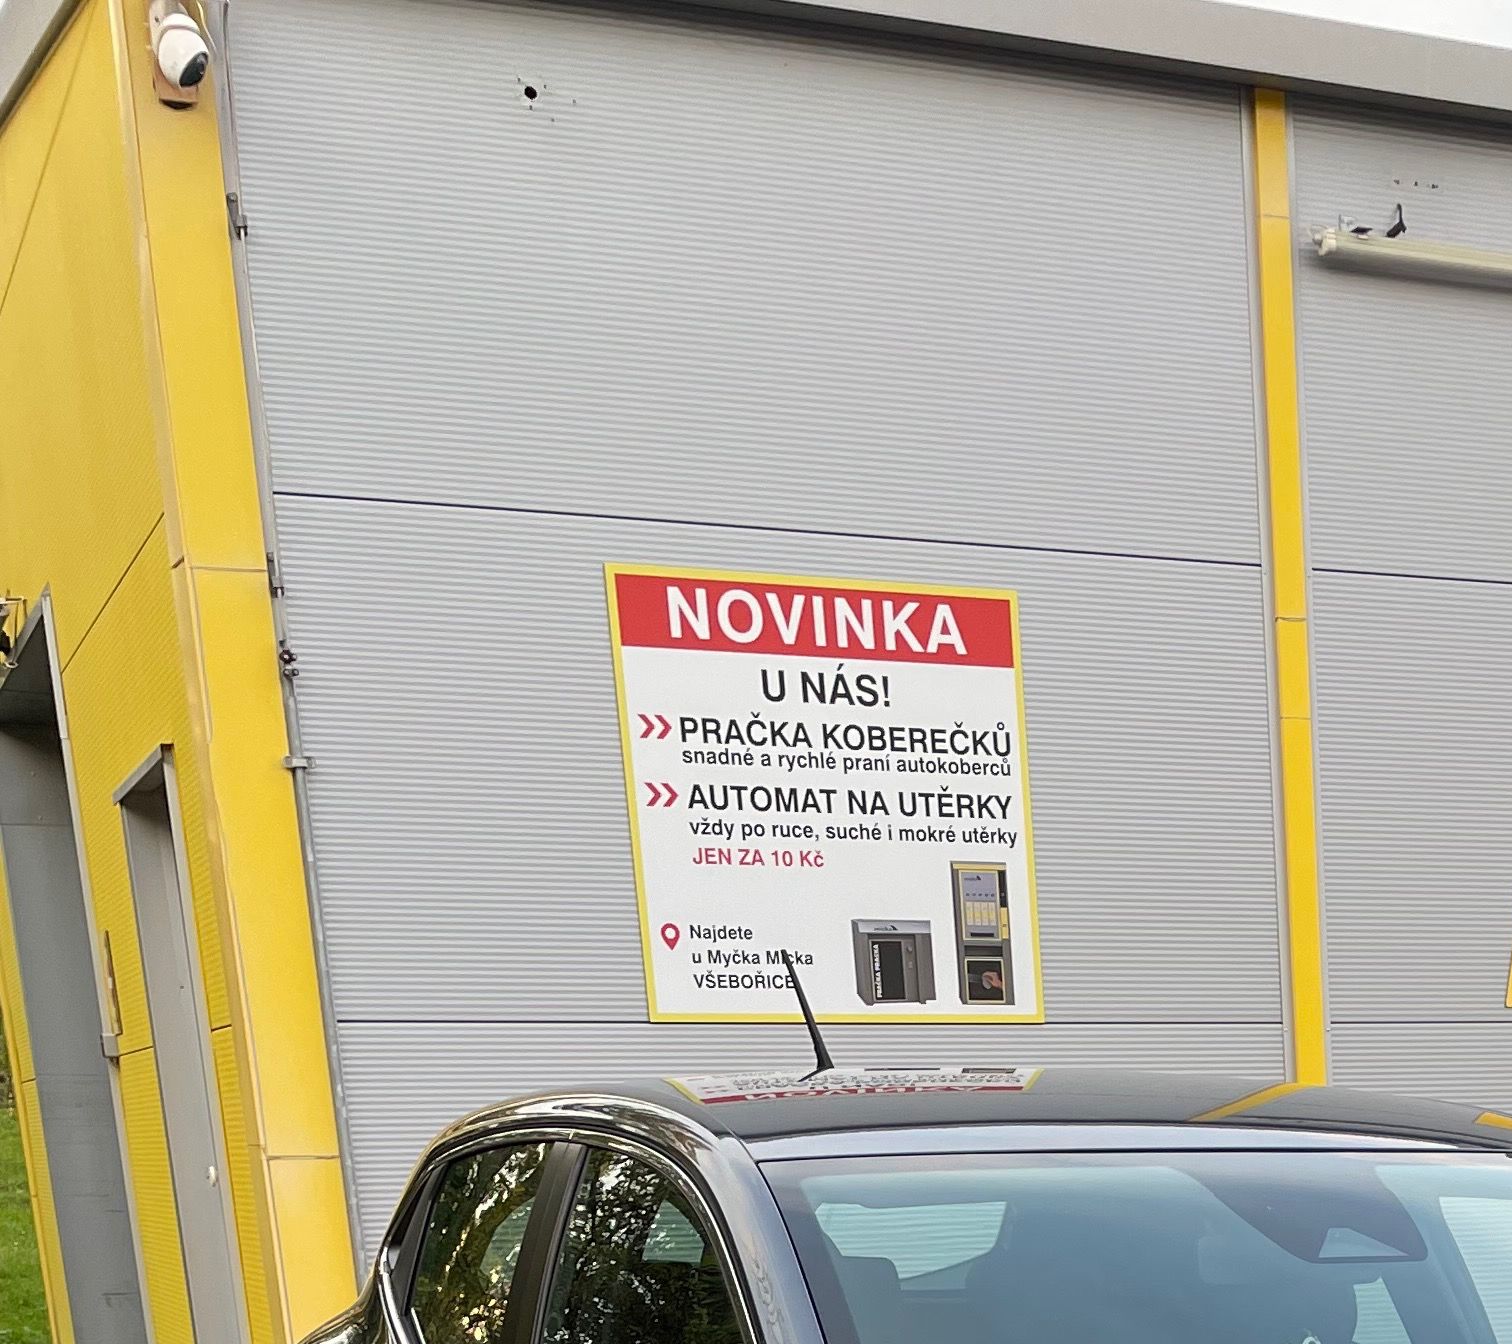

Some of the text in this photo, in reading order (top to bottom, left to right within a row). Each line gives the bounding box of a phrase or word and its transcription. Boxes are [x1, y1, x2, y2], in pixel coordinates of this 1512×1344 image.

[666, 586, 968, 655] NOVINKA
[761, 663, 891, 707] U NÁS!
[680, 711, 1012, 758] PRAČKA KOBEREČKŮ
[682, 747, 1011, 776] snadné a rychlé praní autokoberců
[688, 784, 1012, 819] AUTOMAT NA UTĚRKY
[689, 817, 1018, 848] vždy po ruce, suché i mokré utěrky
[692, 847, 825, 867] JEN ZA 10 Kč
[689, 924, 753, 943] Najdete
[692, 953, 702, 964] u
[707, 949, 761, 968] Myčka
